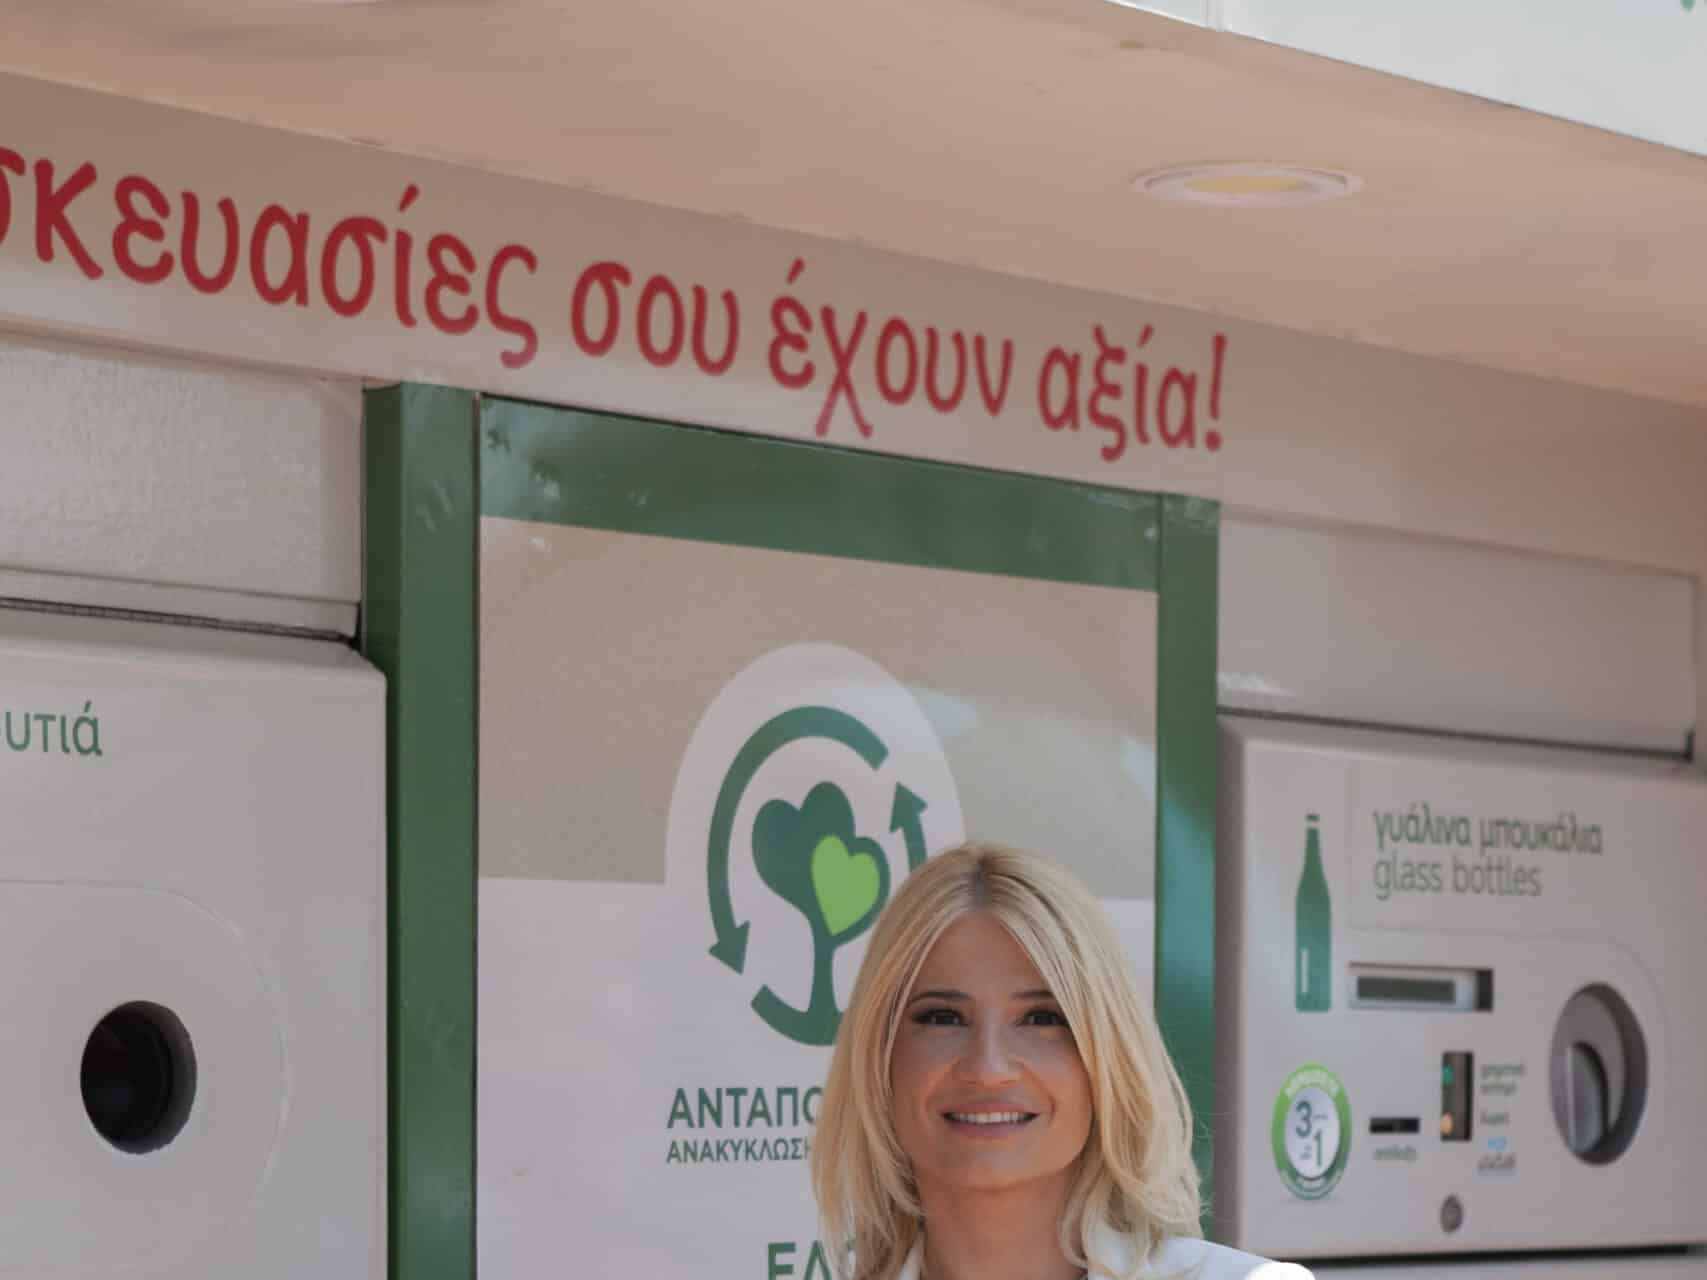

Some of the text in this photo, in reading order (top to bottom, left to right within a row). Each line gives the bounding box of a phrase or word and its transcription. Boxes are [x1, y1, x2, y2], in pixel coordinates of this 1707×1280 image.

[570, 260, 740, 377] σου
[767, 257, 1014, 440] έχουν
[1037, 324, 1228, 462] αξία!
[0, 700, 103, 757] υτιά
[1373, 801, 1603, 857] γυάλινα μπουκάλια
[1374, 851, 1543, 901] glass bottles
